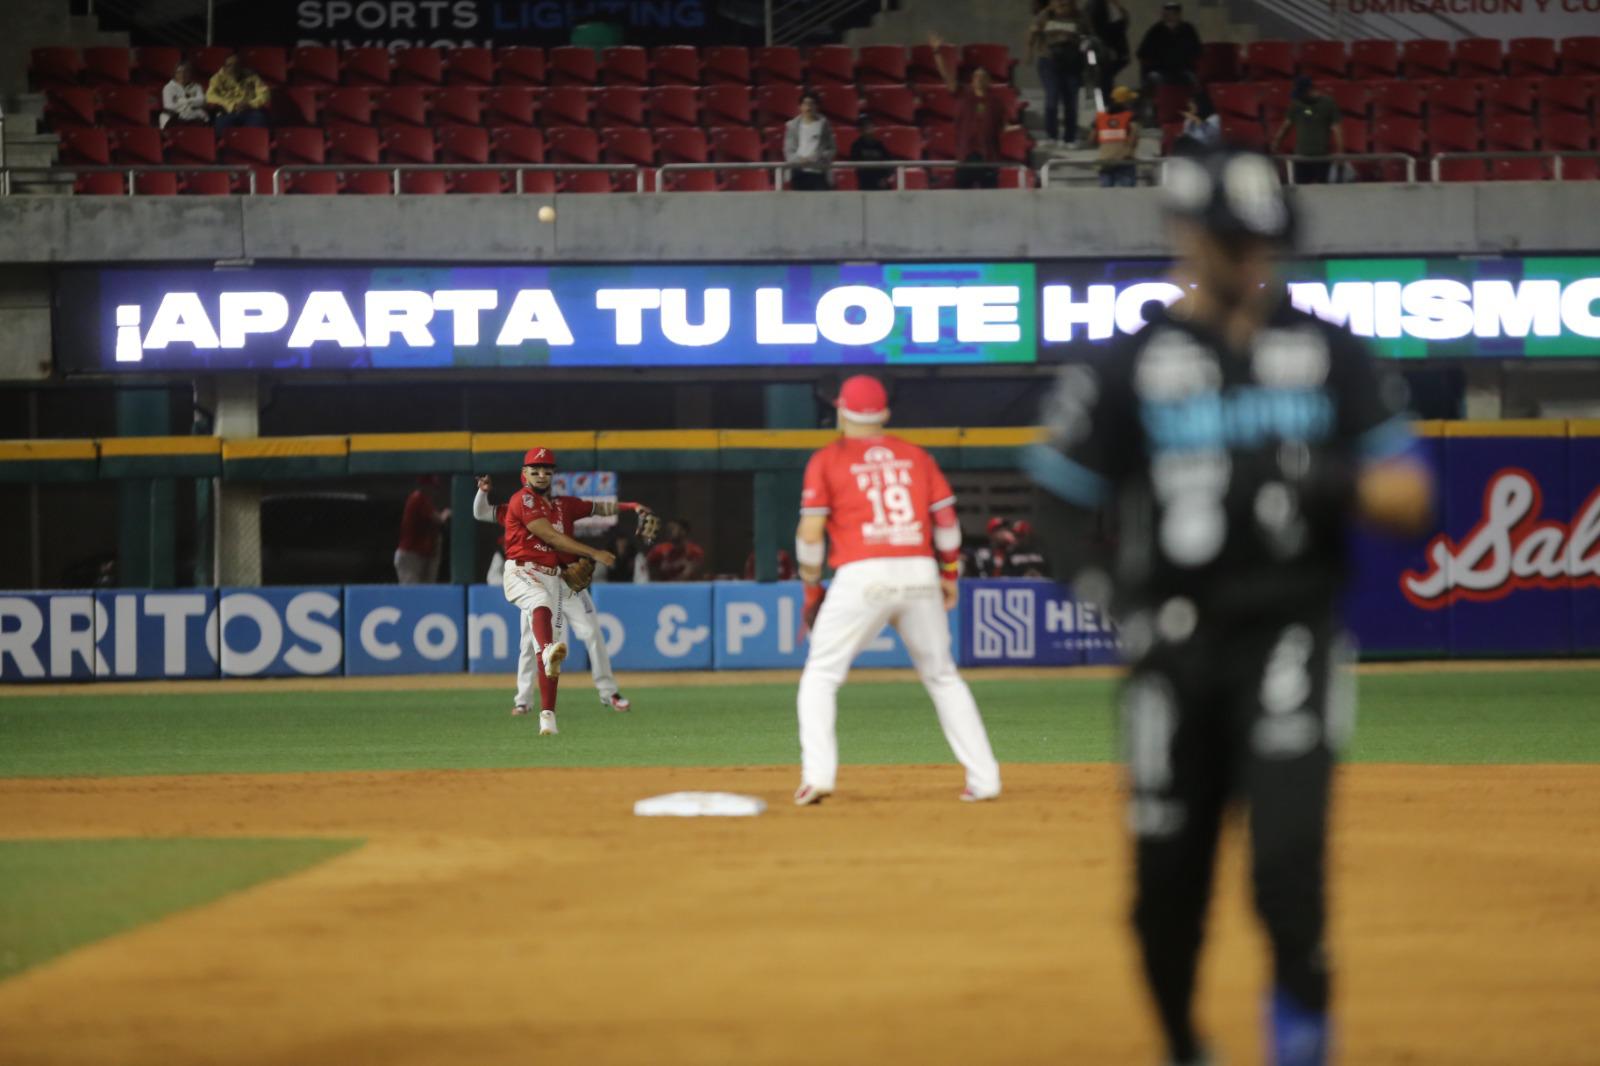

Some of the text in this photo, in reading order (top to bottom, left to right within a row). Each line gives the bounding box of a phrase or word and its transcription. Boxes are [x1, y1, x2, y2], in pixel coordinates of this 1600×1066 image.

[297, 0, 478, 29] SPORTS
[116, 289, 574, 361] ¡APARTA
[596, 288, 730, 346] TU
[756, 285, 1020, 346] LOTE
[1043, 282, 1190, 342] HO
[867, 485, 915, 524] 19
[654, 604, 710, 658] &
